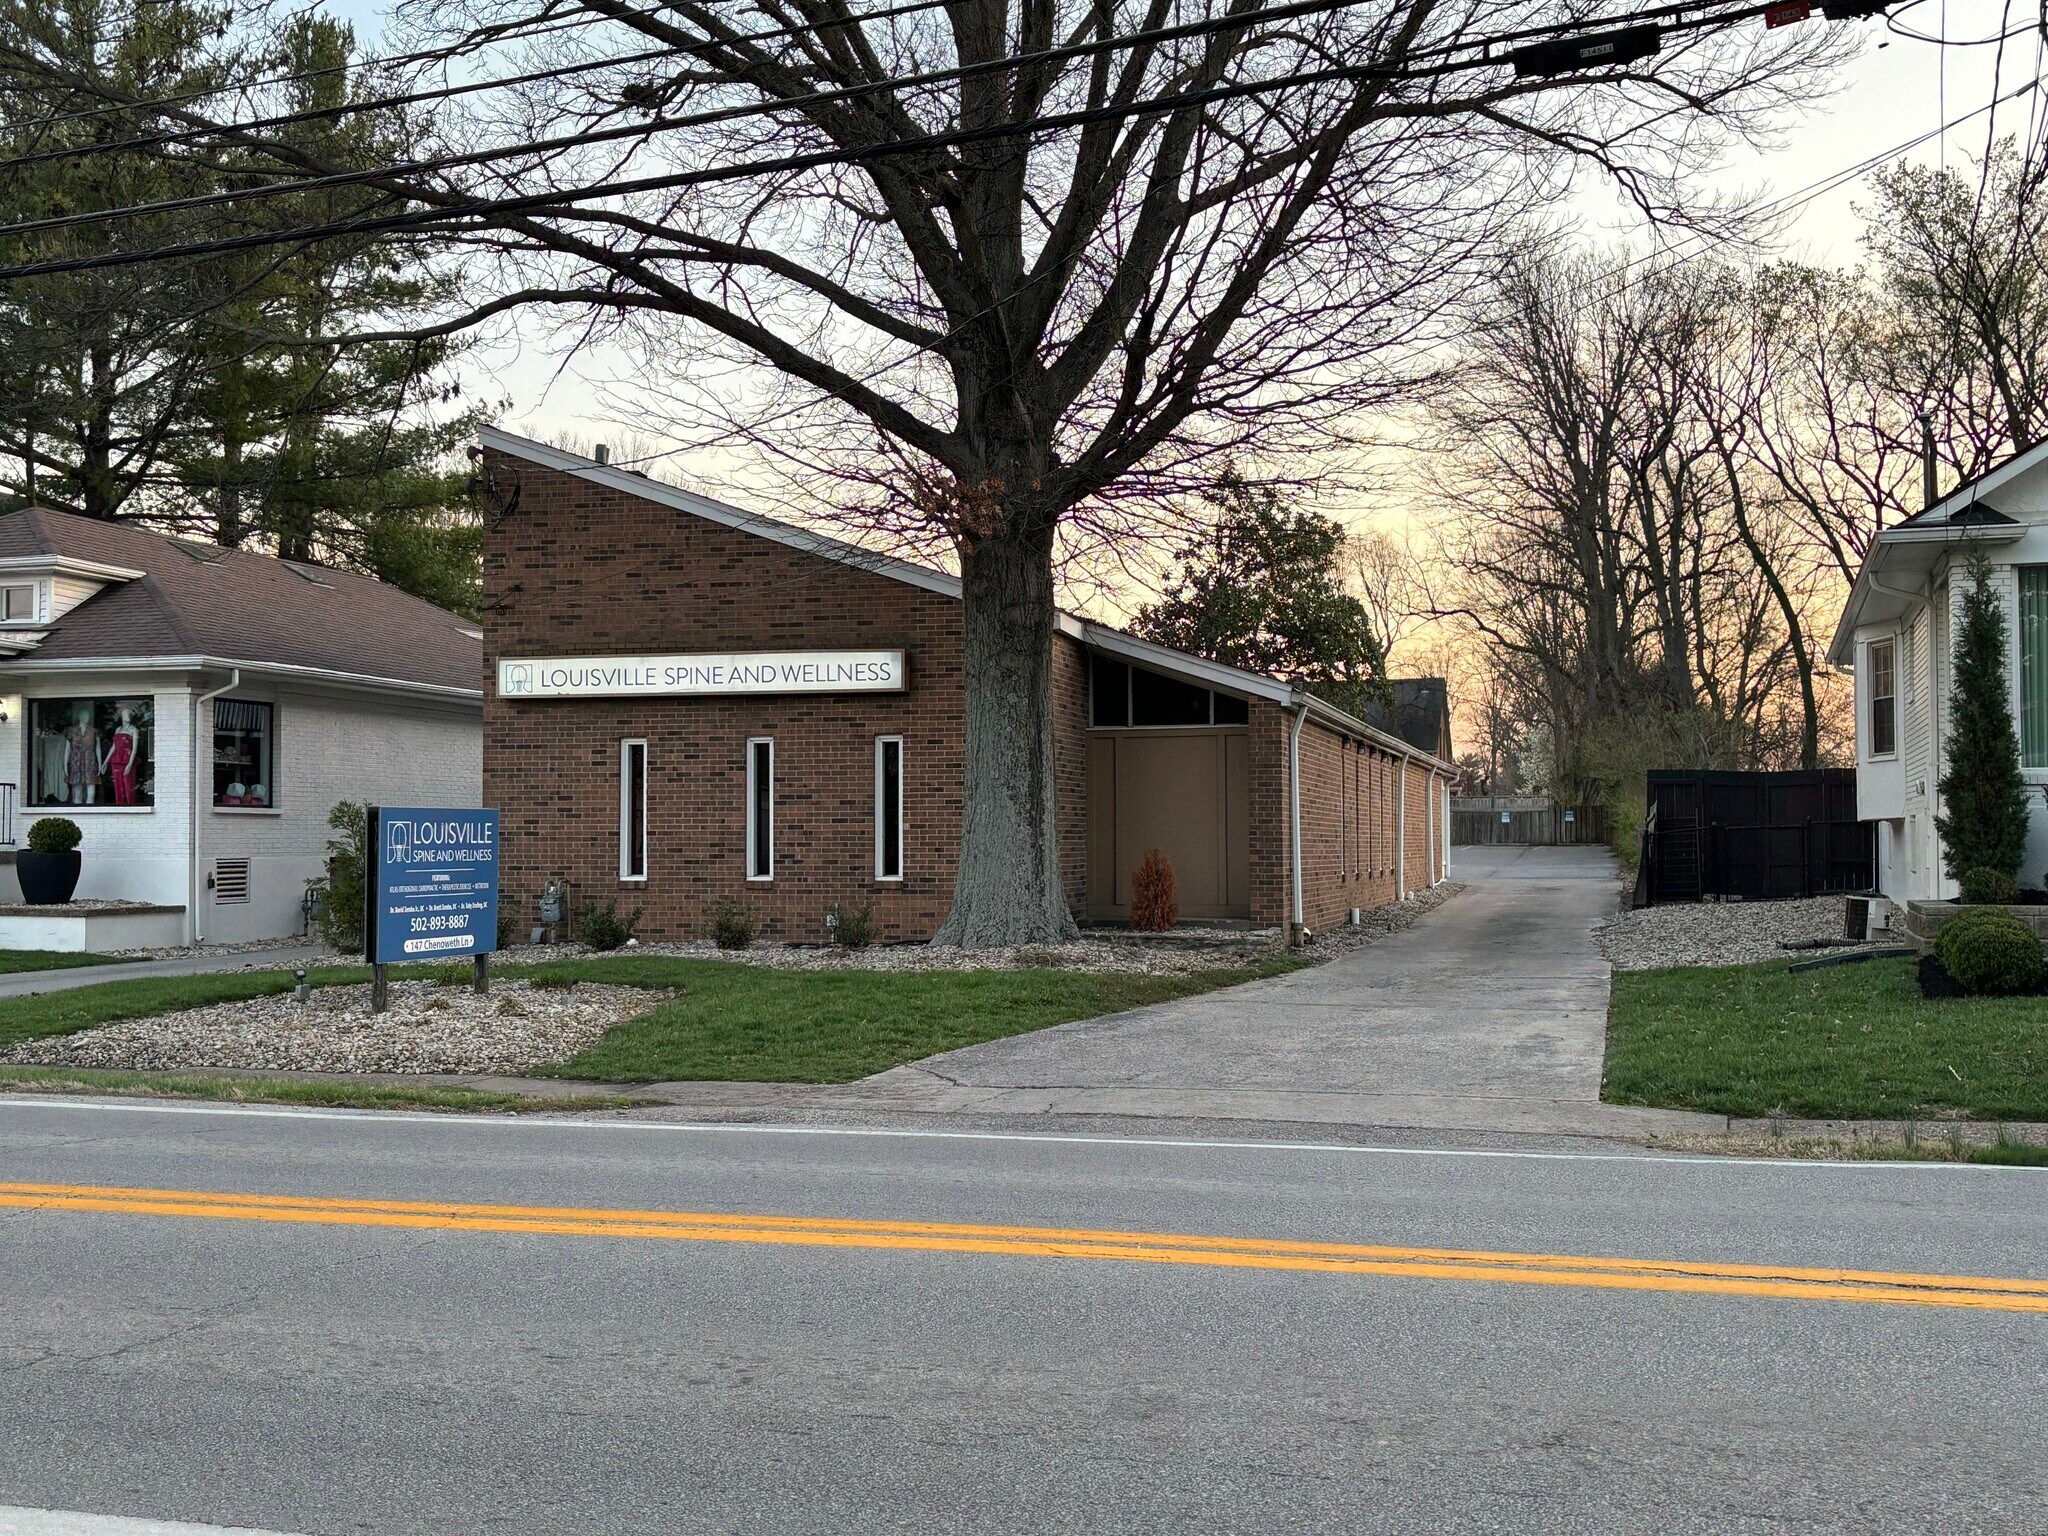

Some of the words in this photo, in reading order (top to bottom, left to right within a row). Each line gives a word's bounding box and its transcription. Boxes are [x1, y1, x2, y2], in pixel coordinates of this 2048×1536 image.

[540, 667, 657, 688] LOUISVILLE
[664, 666, 724, 685] SPINE
[727, 665, 777, 684] AND
[780, 662, 892, 683] WELLNESS
[413, 822, 493, 844] LOUISVILLE
[413, 850, 436, 862] SPINE
[436, 849, 454, 862] AND
[454, 849, 492, 861] WELLNESS
[410, 914, 469, 932] 502-893-8887
[410, 941, 423, 951] 147
[423, 938, 460, 950] Chenoweth
[461, 938, 469, 946] Ln
